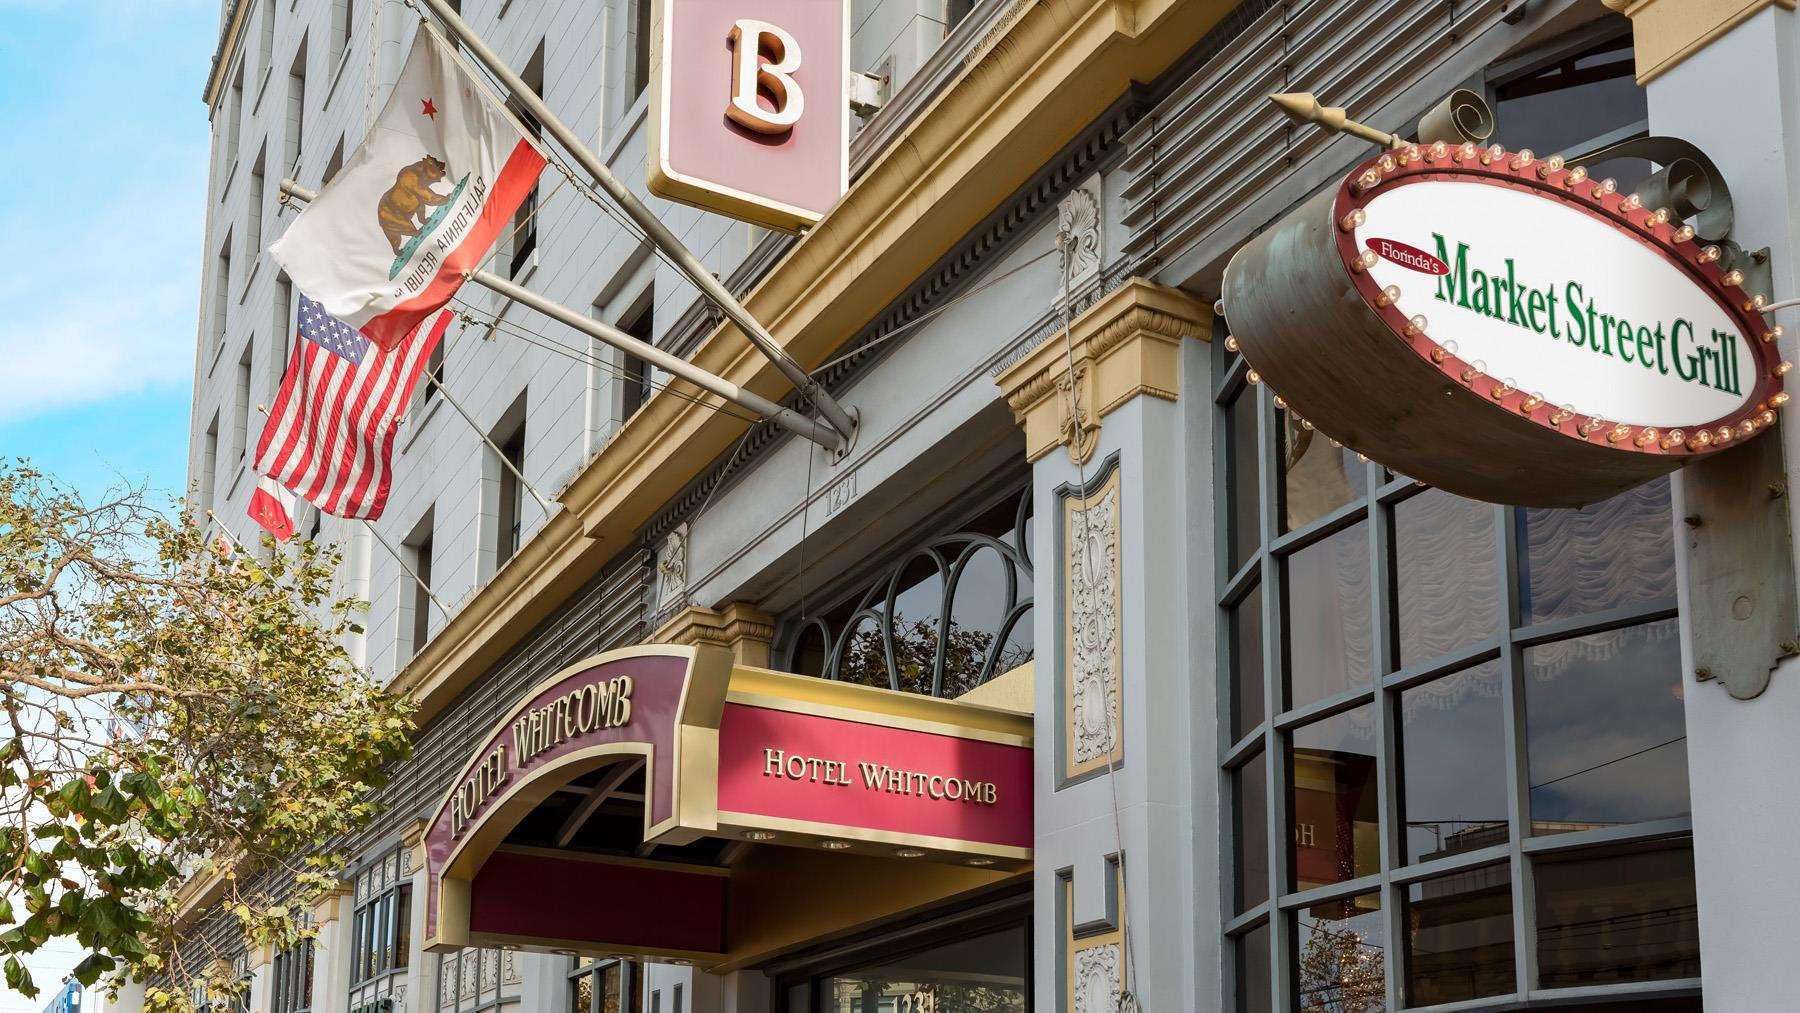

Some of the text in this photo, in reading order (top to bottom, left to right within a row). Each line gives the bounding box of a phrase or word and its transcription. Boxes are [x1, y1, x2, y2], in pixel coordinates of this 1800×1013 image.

[728, 18, 805, 134] B
[1380, 240, 1440, 273] Florinda's
[1431, 231, 1743, 397] Market Street Grill
[823, 471, 858, 518] 1231
[450, 674, 635, 841] HOTEL WHITCOMB
[763, 748, 998, 805] HOTEL WHITCOMB
